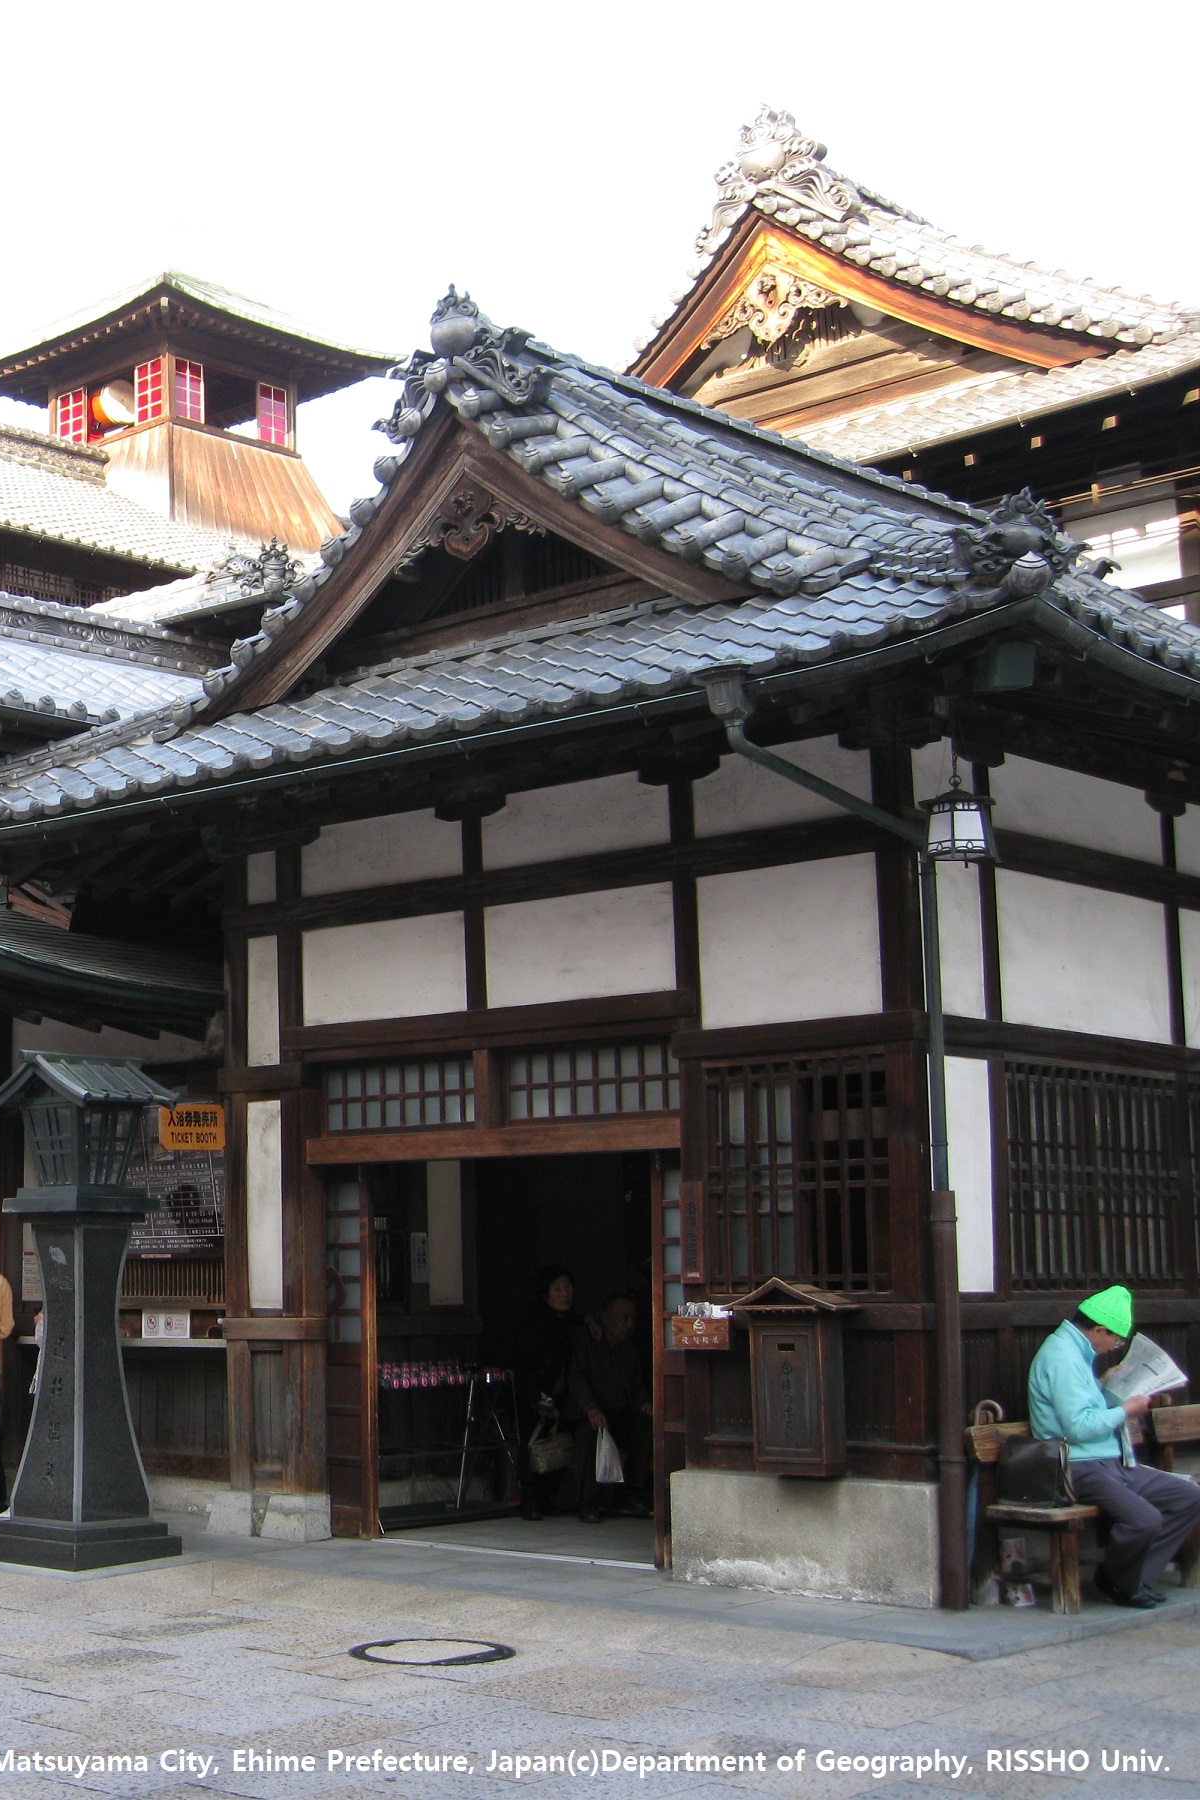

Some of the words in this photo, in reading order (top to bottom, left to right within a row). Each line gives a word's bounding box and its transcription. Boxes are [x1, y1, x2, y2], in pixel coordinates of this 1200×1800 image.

[167, 1110, 218, 1128] 入浴券発売所
[170, 1131, 193, 1144] TICKET
[196, 1131, 217, 1144] BOOTH
